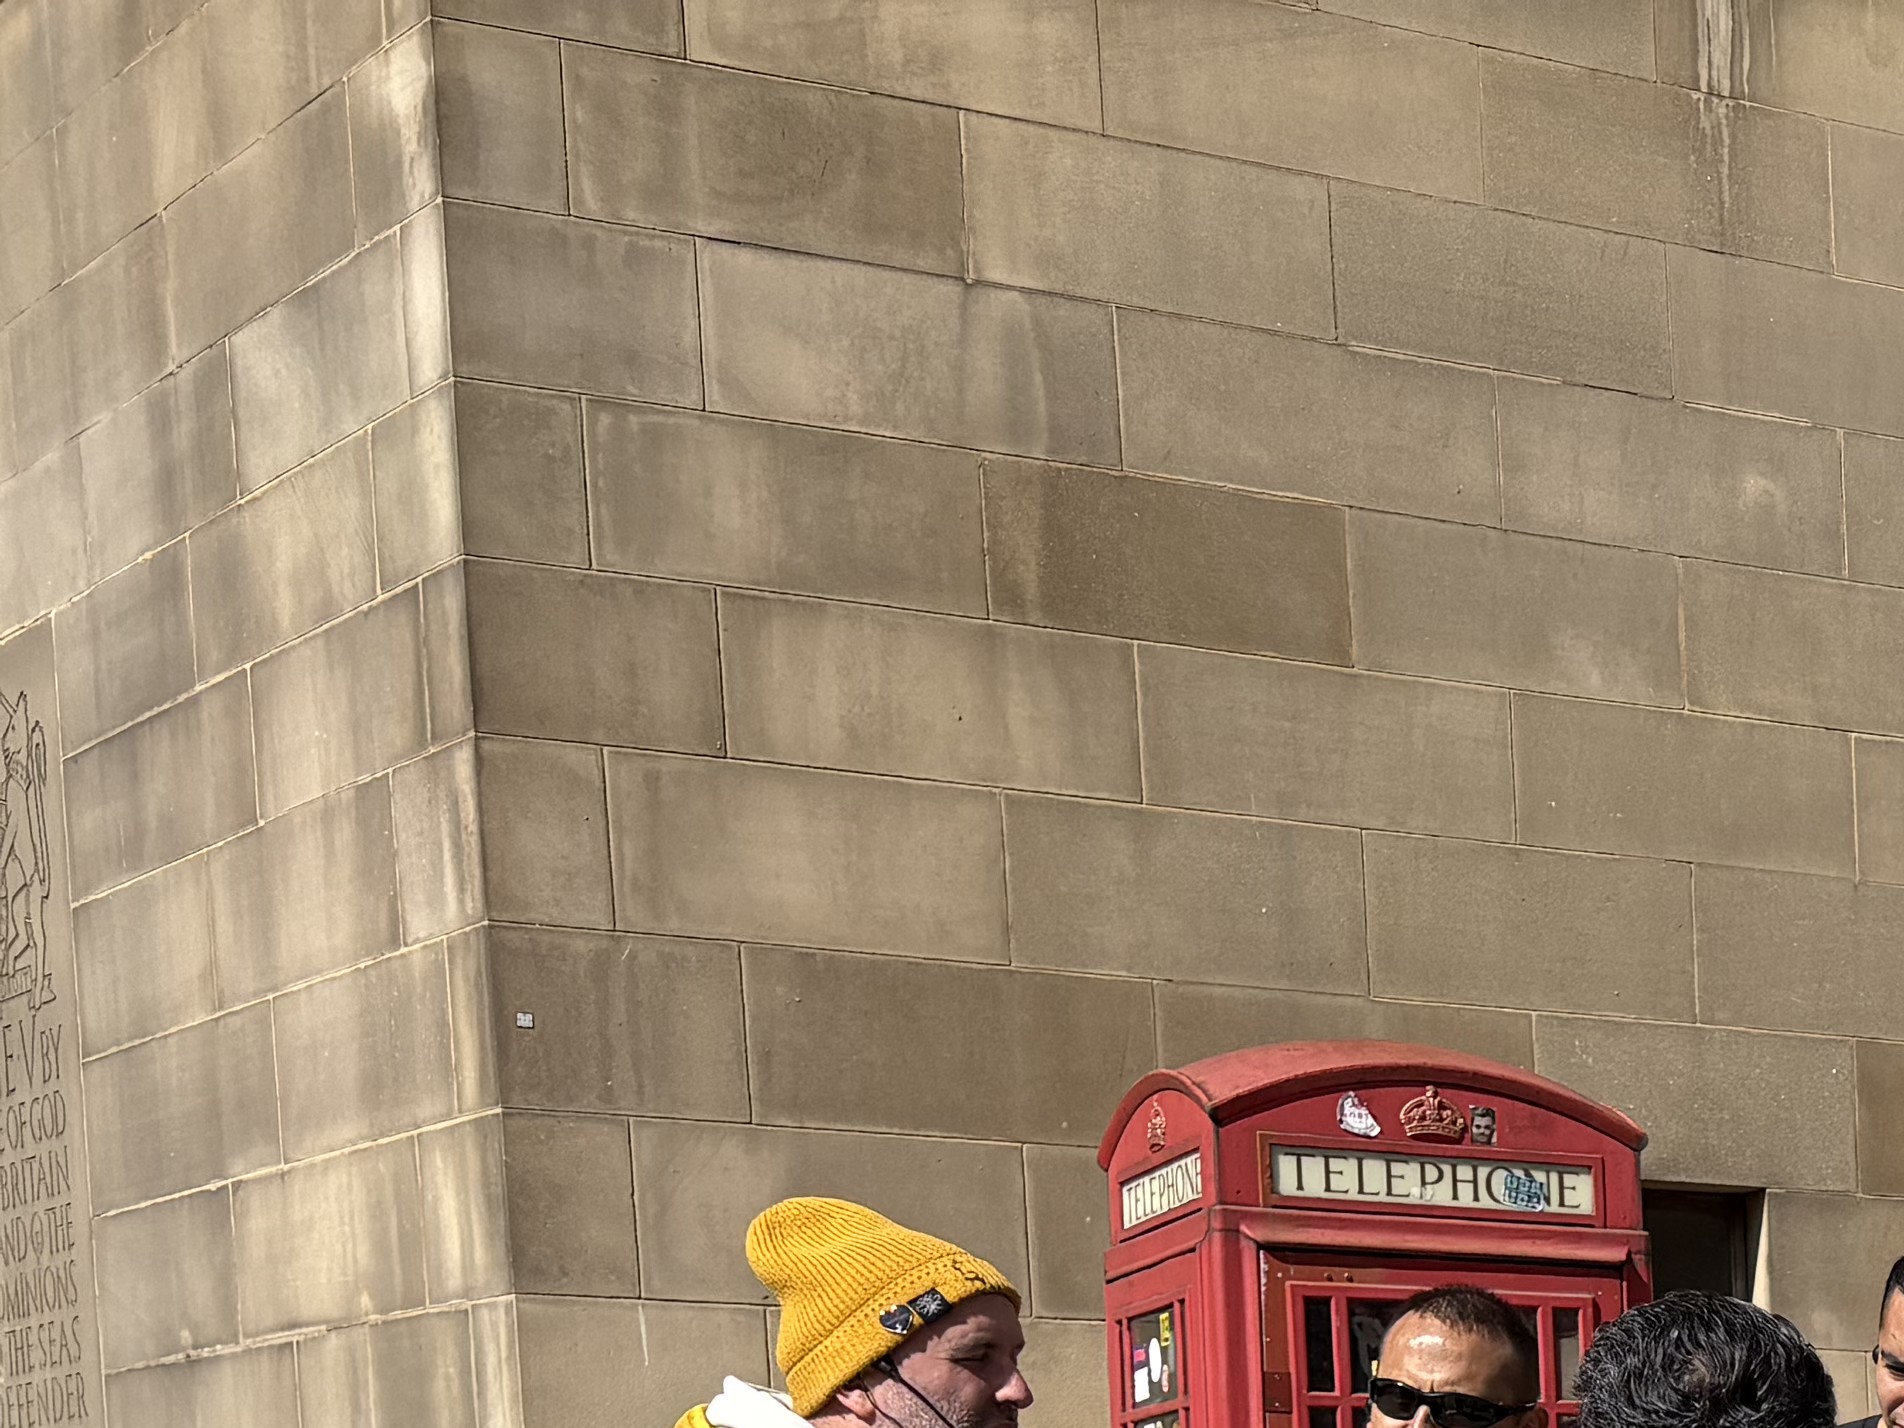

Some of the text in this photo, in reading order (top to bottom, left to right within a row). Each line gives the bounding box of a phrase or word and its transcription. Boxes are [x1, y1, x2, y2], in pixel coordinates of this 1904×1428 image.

[40, 1023, 62, 1083] BY
[7, 1101, 26, 1150] OF
[30, 1090, 66, 1143] GOD
[0, 1145, 71, 1211] BRITAIN
[1126, 1157, 1202, 1225] TELEPHONE
[44, 1202, 75, 1255] THE
[5, 1315, 81, 1377] THE SEAS
